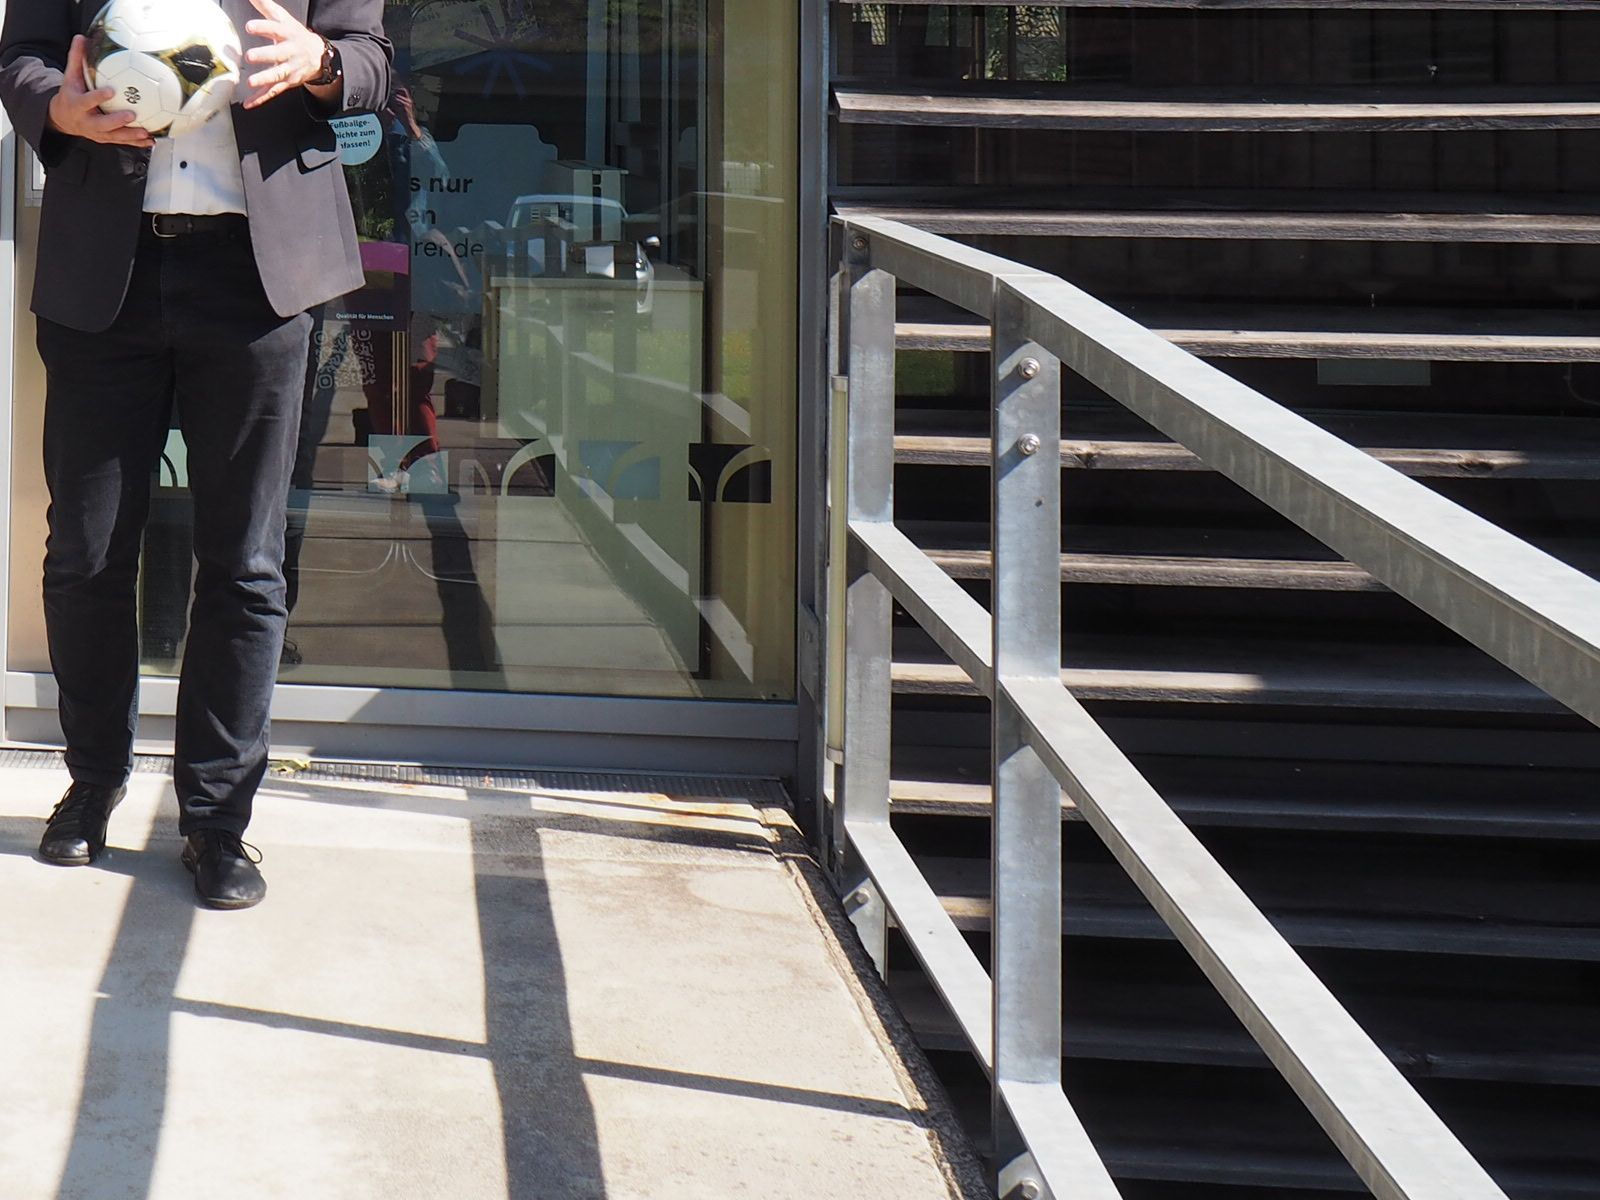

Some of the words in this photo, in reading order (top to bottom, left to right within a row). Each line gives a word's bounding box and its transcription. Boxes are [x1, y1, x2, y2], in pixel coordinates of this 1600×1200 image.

[359, 128, 376, 137] zum
[429, 176, 473, 193] nur
[335, 312, 358, 320] Qualität
[358, 312, 366, 320] für
[367, 312, 395, 320] Menschen
